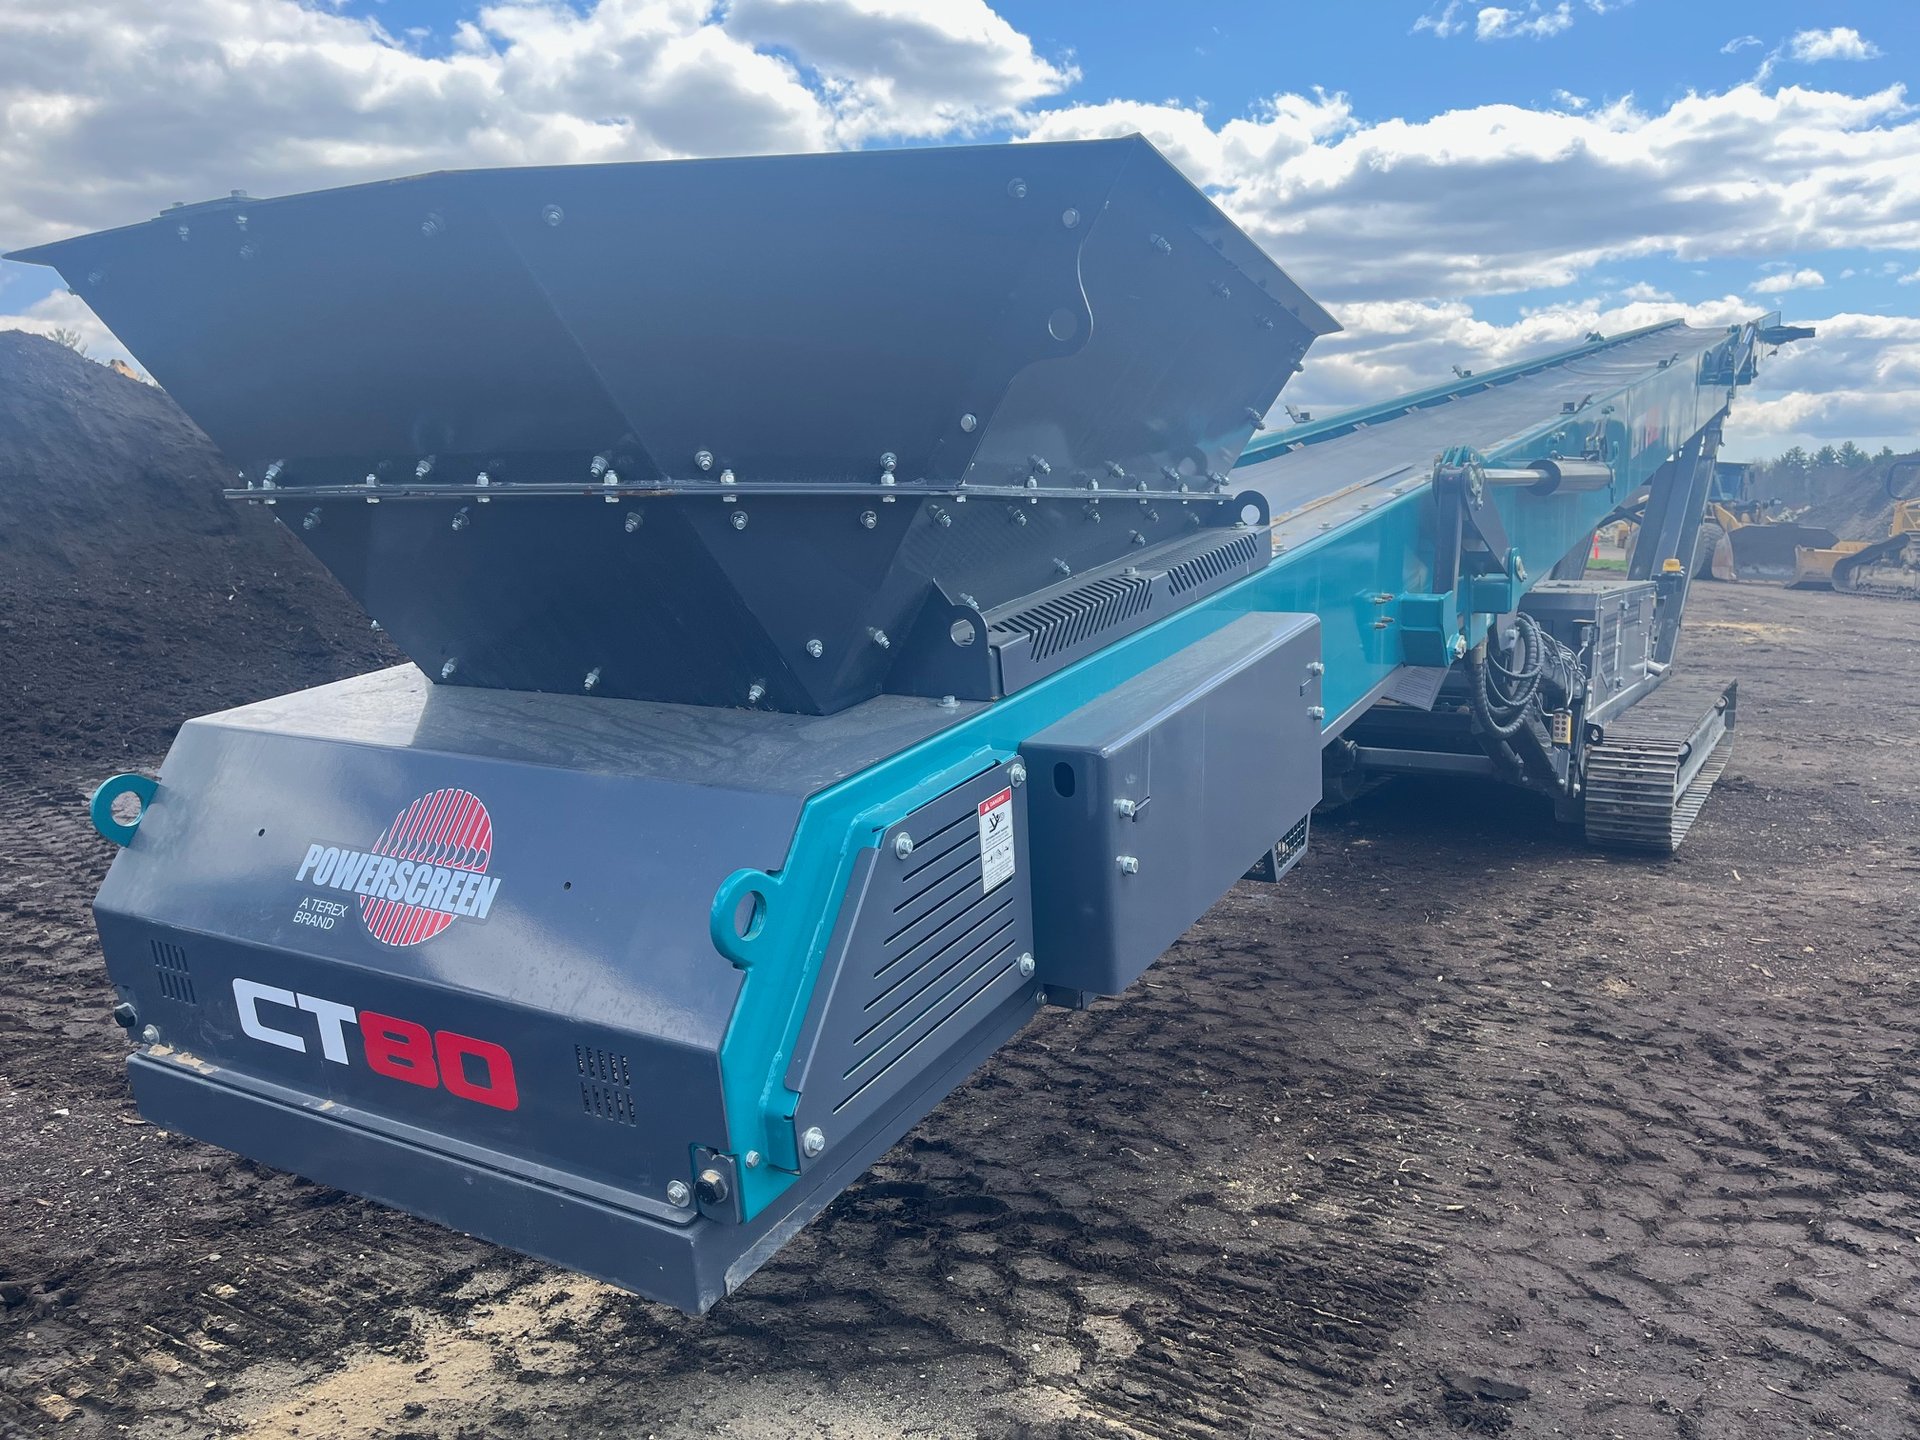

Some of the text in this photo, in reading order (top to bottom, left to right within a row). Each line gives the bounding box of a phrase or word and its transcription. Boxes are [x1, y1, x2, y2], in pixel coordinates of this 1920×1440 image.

[989, 795, 1005, 808] DANGER
[295, 843, 501, 919] POWERSCREEN
[299, 897, 349, 917] A TEREX
[293, 910, 335, 930] BRAND
[232, 978, 519, 1111] CT80
